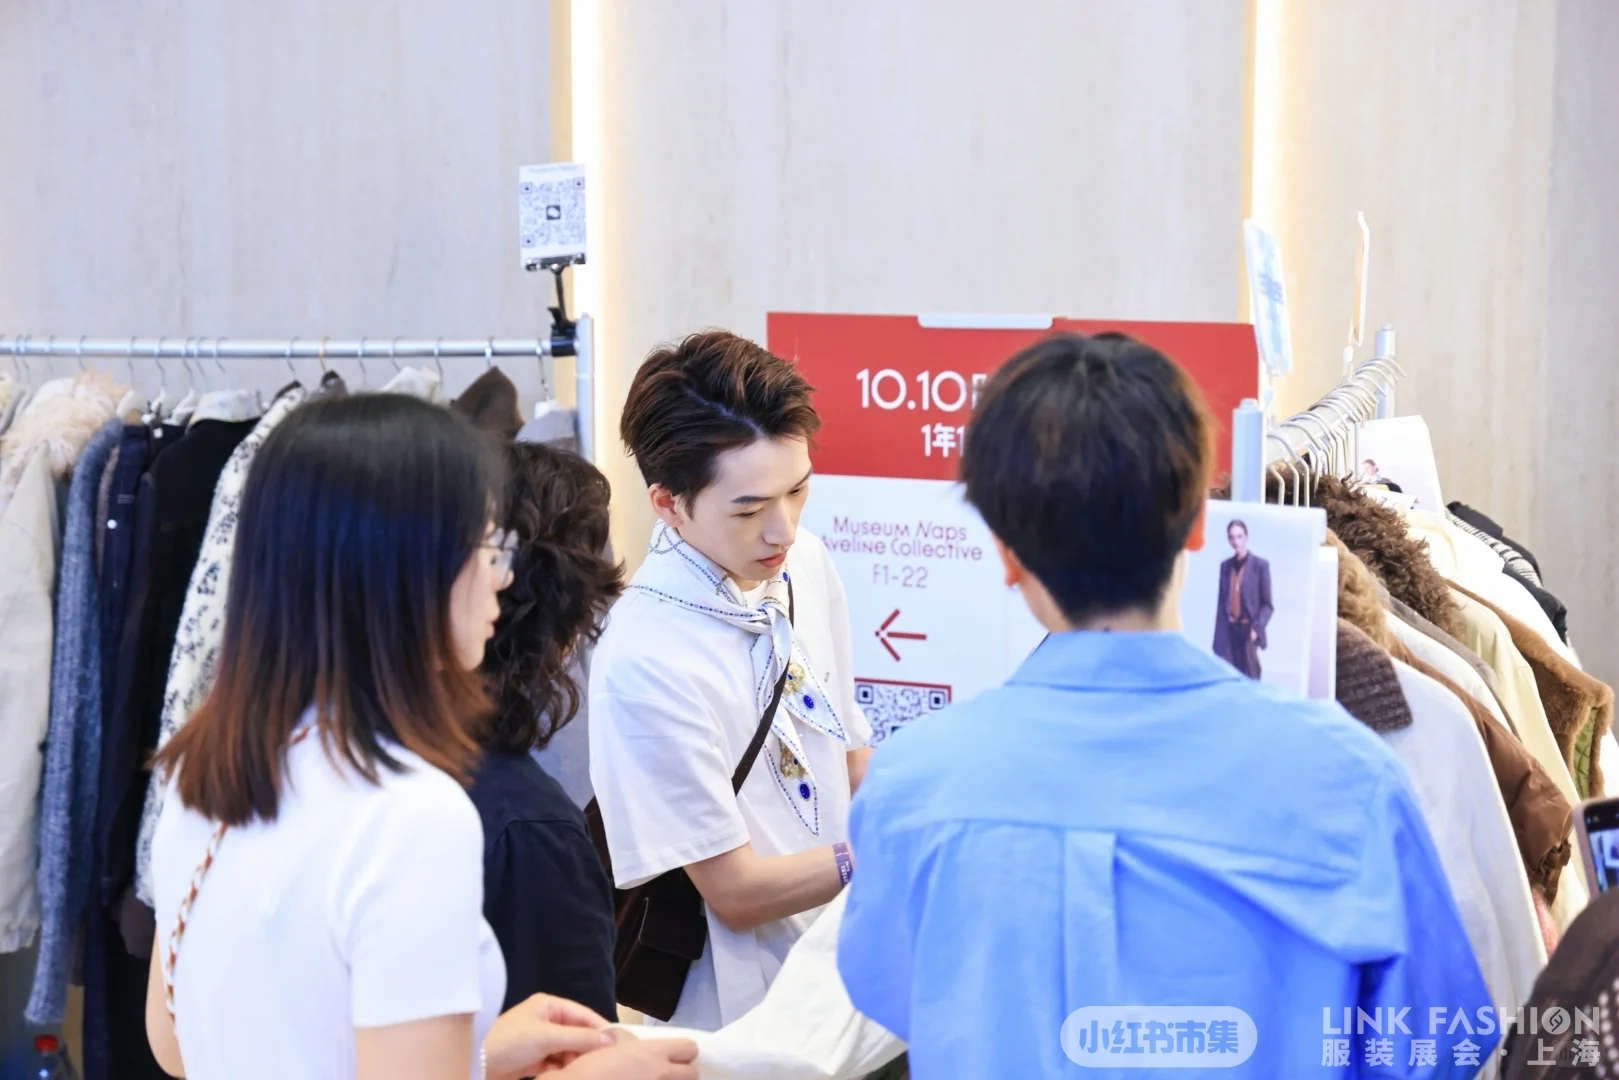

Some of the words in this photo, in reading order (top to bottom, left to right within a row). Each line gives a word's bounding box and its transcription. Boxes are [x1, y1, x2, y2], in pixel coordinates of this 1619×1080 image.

[916, 520, 967, 543] Naps
[891, 538, 983, 561] Collective
[872, 563, 928, 588] F1-22
